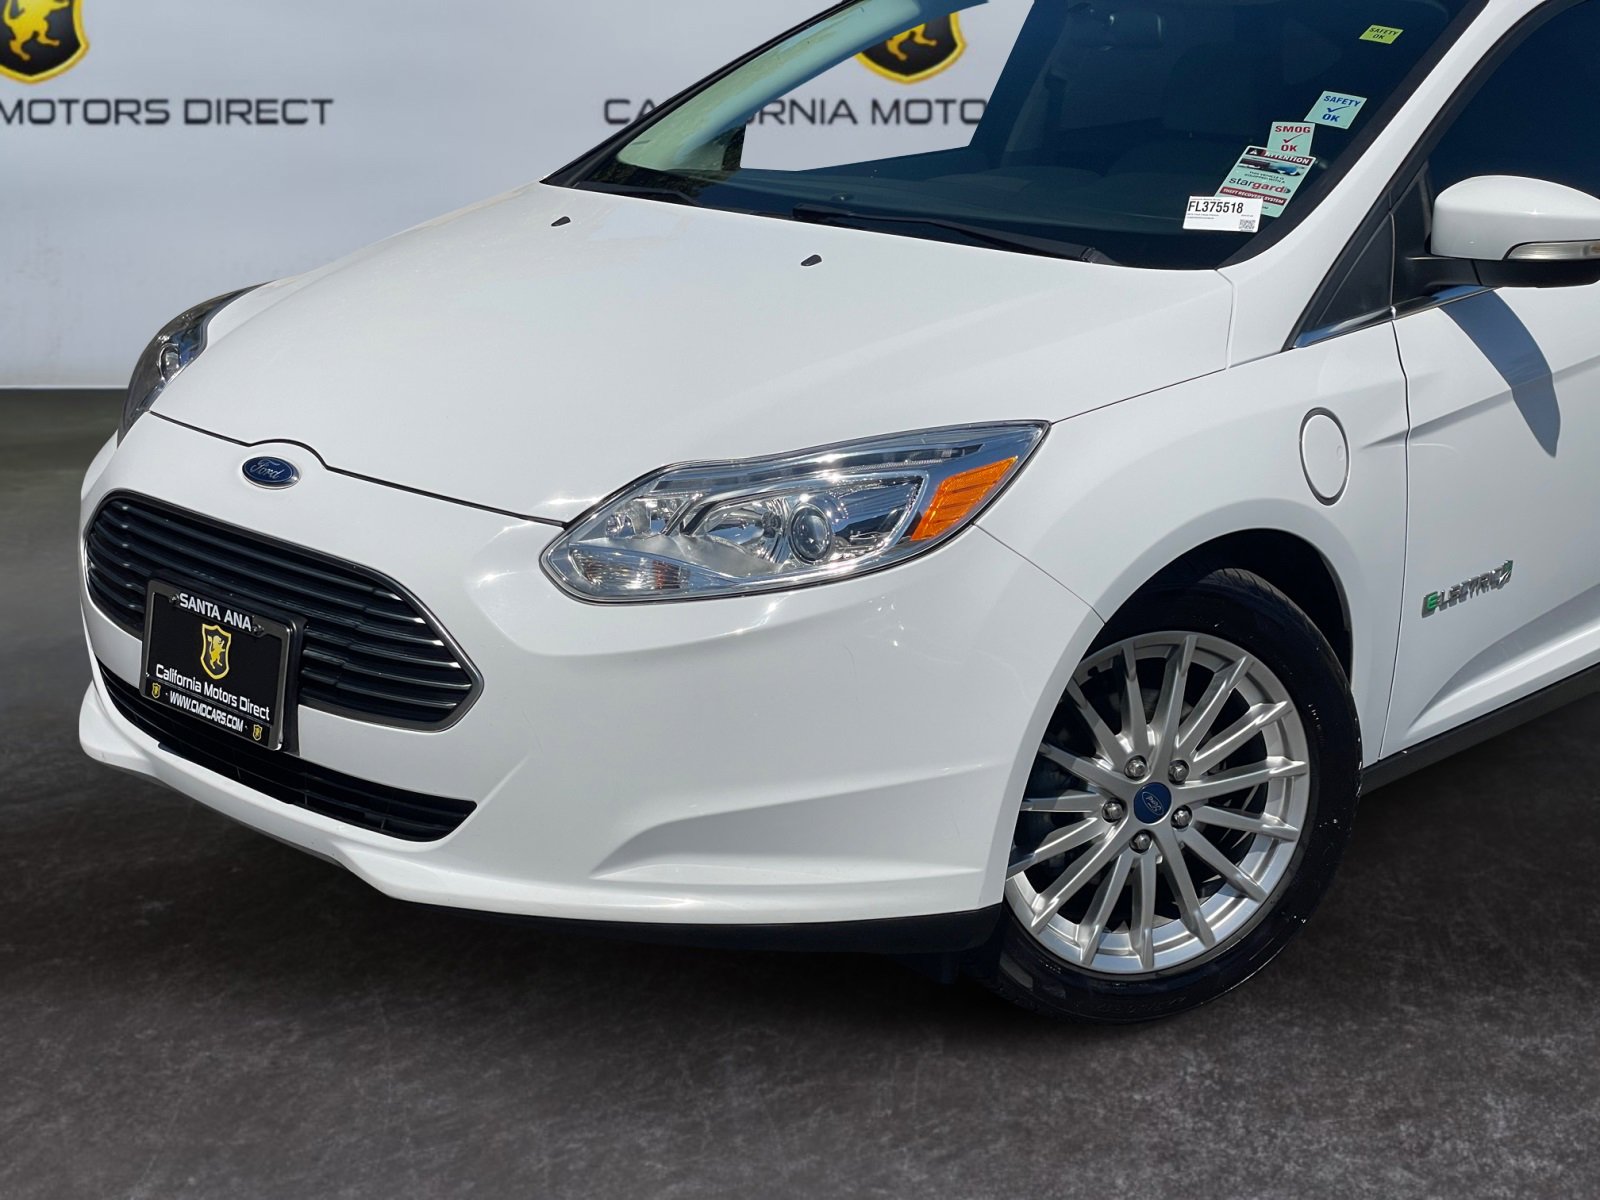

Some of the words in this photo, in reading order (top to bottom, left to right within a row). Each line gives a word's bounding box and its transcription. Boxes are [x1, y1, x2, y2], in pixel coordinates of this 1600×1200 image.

[1370, 28, 1399, 36] SAFETY
[1323, 95, 1361, 107] SAFETY
[0, 98, 170, 125] MOTORS
[183, 98, 334, 125] DIRECT
[604, 98, 858, 125] CARNIA
[871, 98, 988, 125] MOTO
[1322, 113, 1340, 122] OK
[1275, 125, 1311, 133] SMOG
[1281, 144, 1298, 152] OK
[1264, 152, 1310, 164] ATTENTION
[1228, 177, 1285, 193] stargard
[1188, 200, 1244, 213] FL375518
[179, 592, 221, 621] SANTA
[223, 609, 252, 632] ANA
[155, 663, 202, 693] California
[203, 681, 238, 708] Motors
[239, 695, 270, 721] Direct
[169, 690, 244, 732] WWW.CMDCARS.COM
